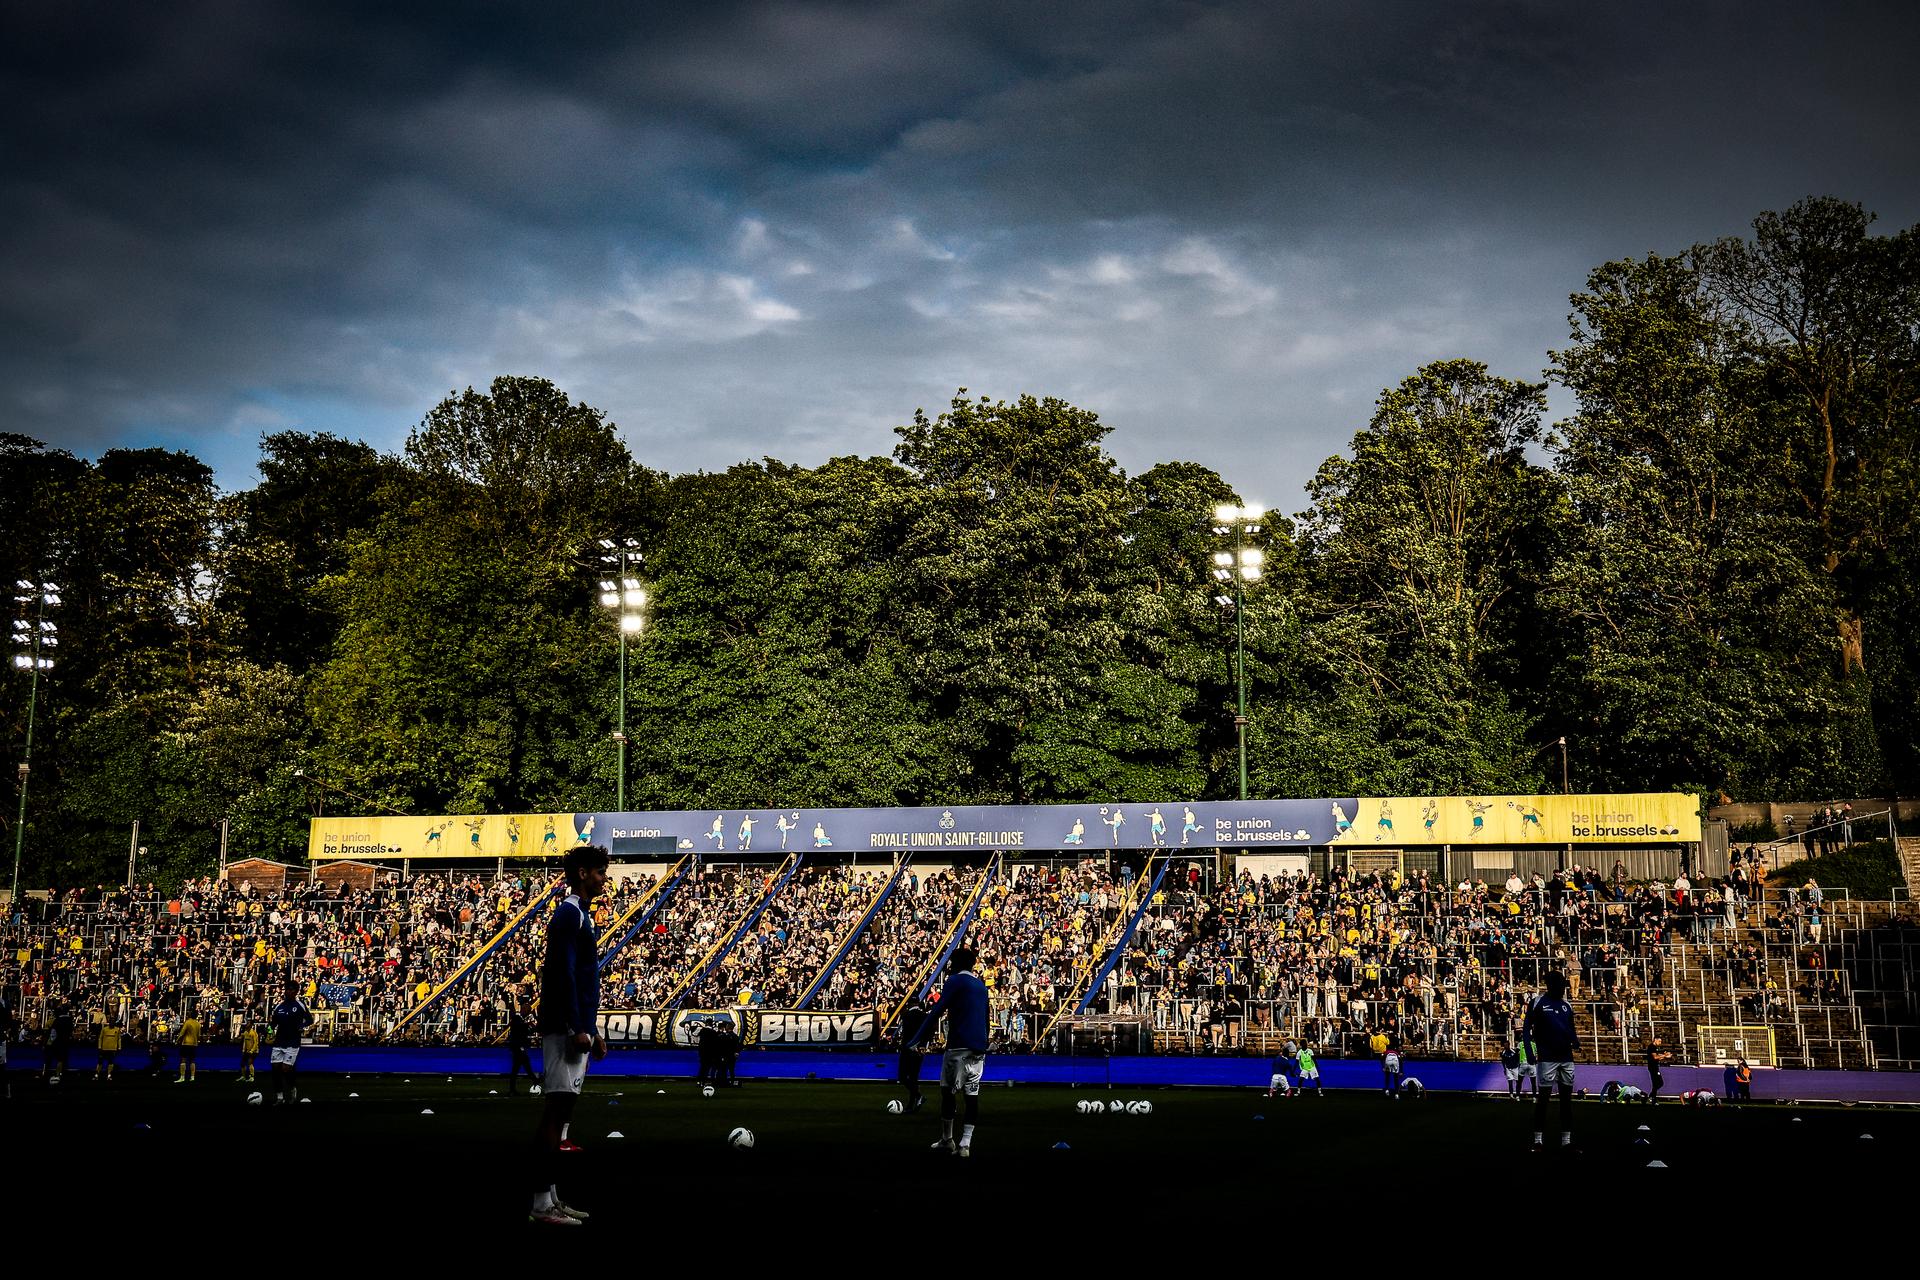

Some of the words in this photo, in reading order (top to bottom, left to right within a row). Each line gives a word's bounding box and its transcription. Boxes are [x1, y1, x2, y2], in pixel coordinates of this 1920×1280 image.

[1215, 818, 1232, 829] be
[1236, 817, 1272, 829] union
[1571, 811, 1589, 823] be
[1595, 811, 1634, 823] union
[324, 832, 338, 842] be
[342, 832, 371, 842] union
[612, 827, 626, 838] be
[630, 826, 661, 838] union
[871, 833, 908, 847] ROYALE
[911, 832, 943, 847] UNION
[945, 831, 1024, 846] SAINT-GILLOISE
[761, 1013, 873, 1042] BHOYS
